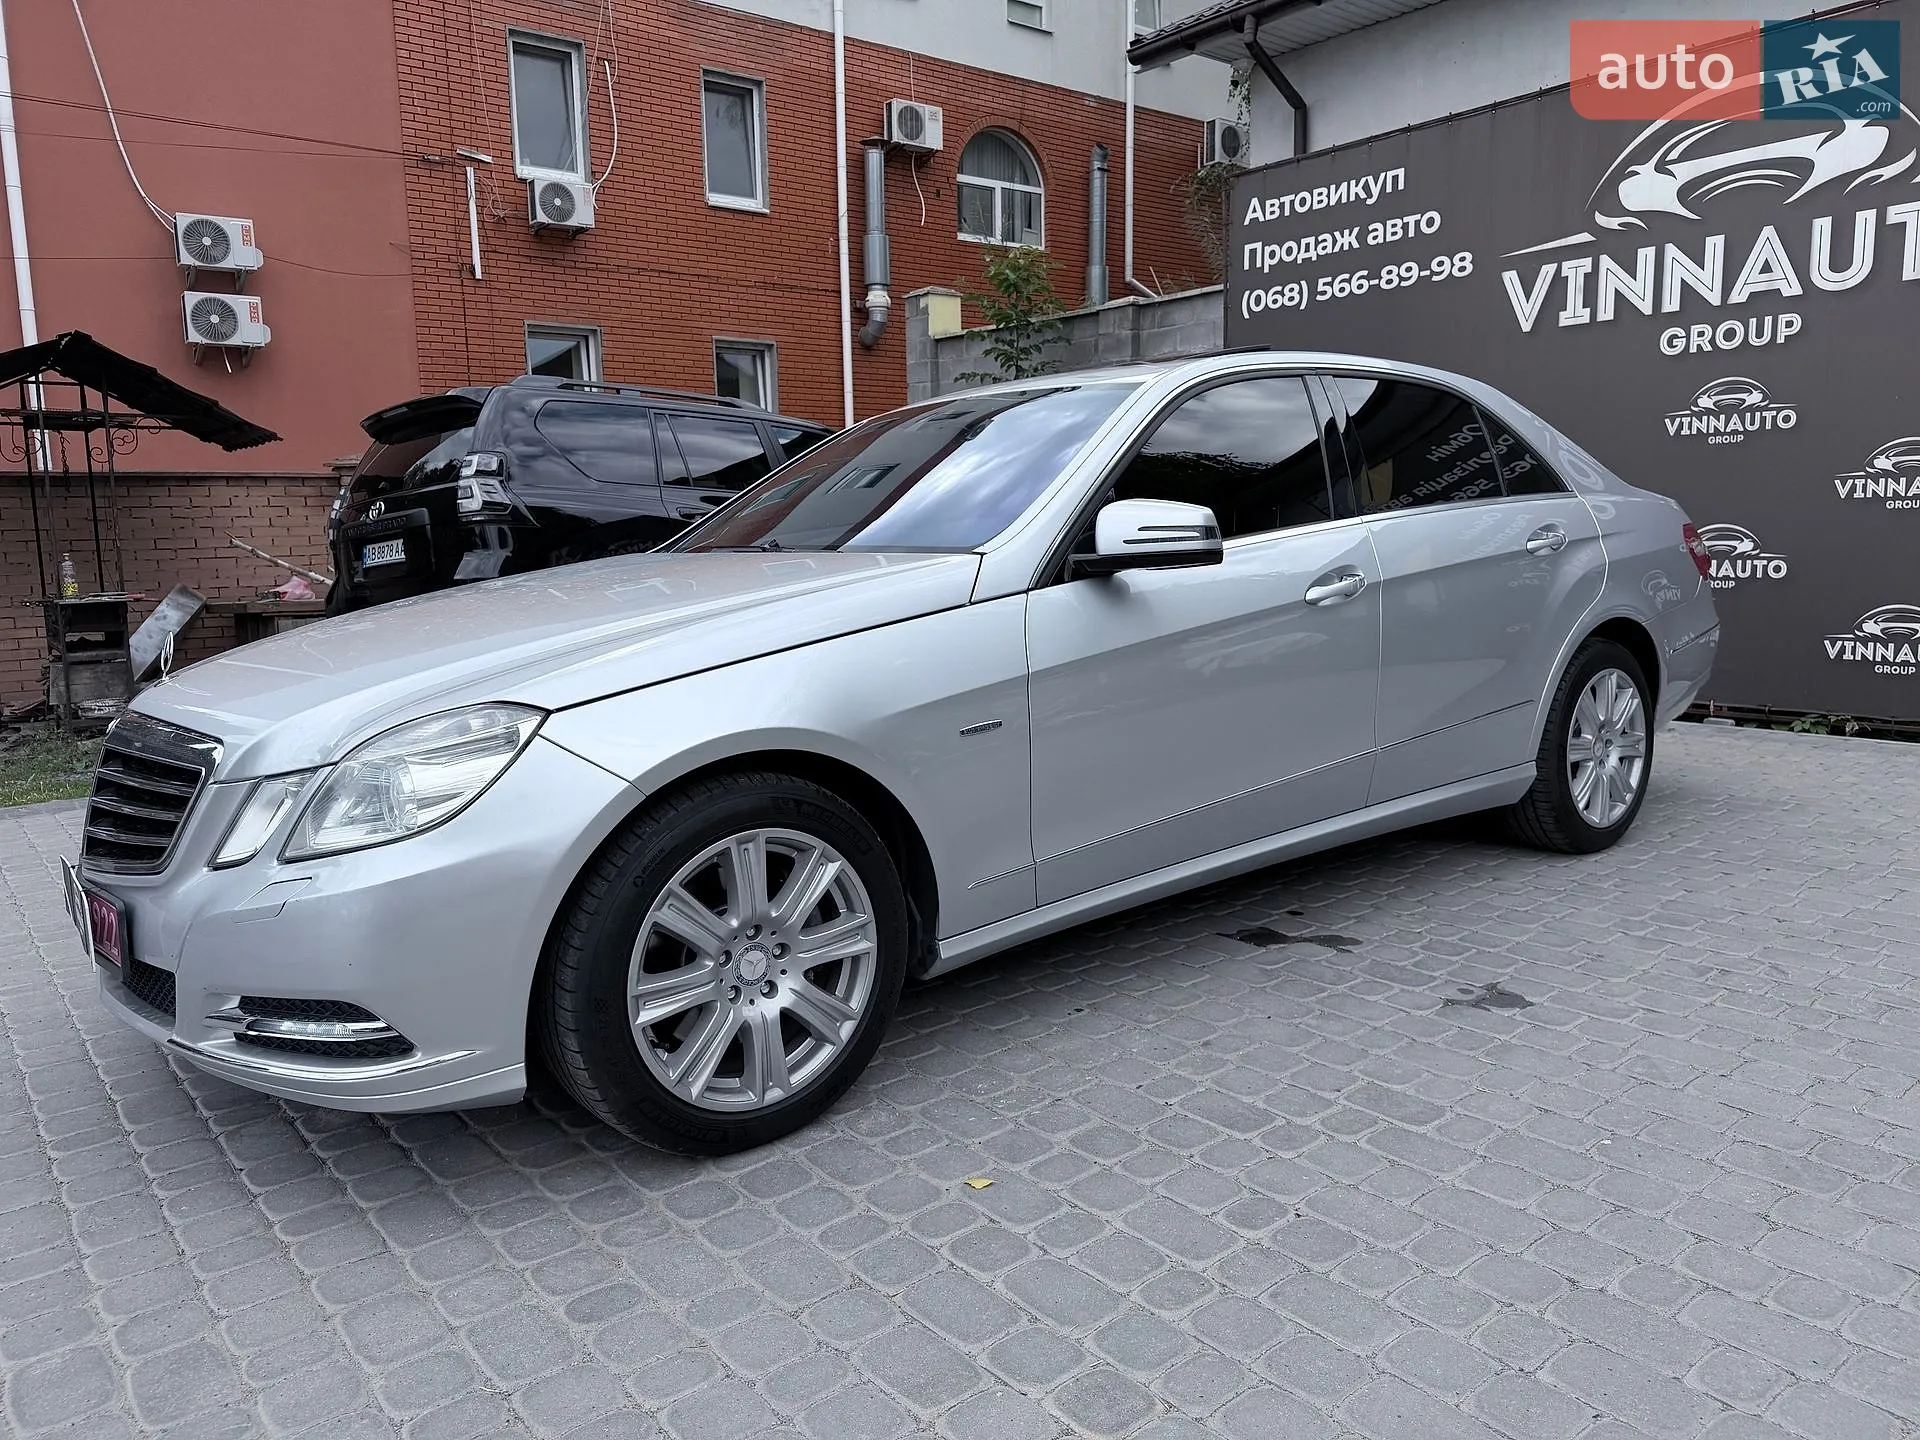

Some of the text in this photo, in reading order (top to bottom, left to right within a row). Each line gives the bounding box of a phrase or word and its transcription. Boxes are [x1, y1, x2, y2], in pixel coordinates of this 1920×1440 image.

[1243, 167, 1406, 226] Автовикуп
[1243, 210, 1442, 273] Продаж авто
[1241, 251, 1475, 320] (068) 566-89-98
[1659, 312, 1802, 356] GROUP
[1663, 409, 1798, 437] VINNAUTO
[1707, 434, 1744, 445] GROUP
[1823, 640, 1920, 664] VINNA
[1874, 664, 1917, 676] GROUP
